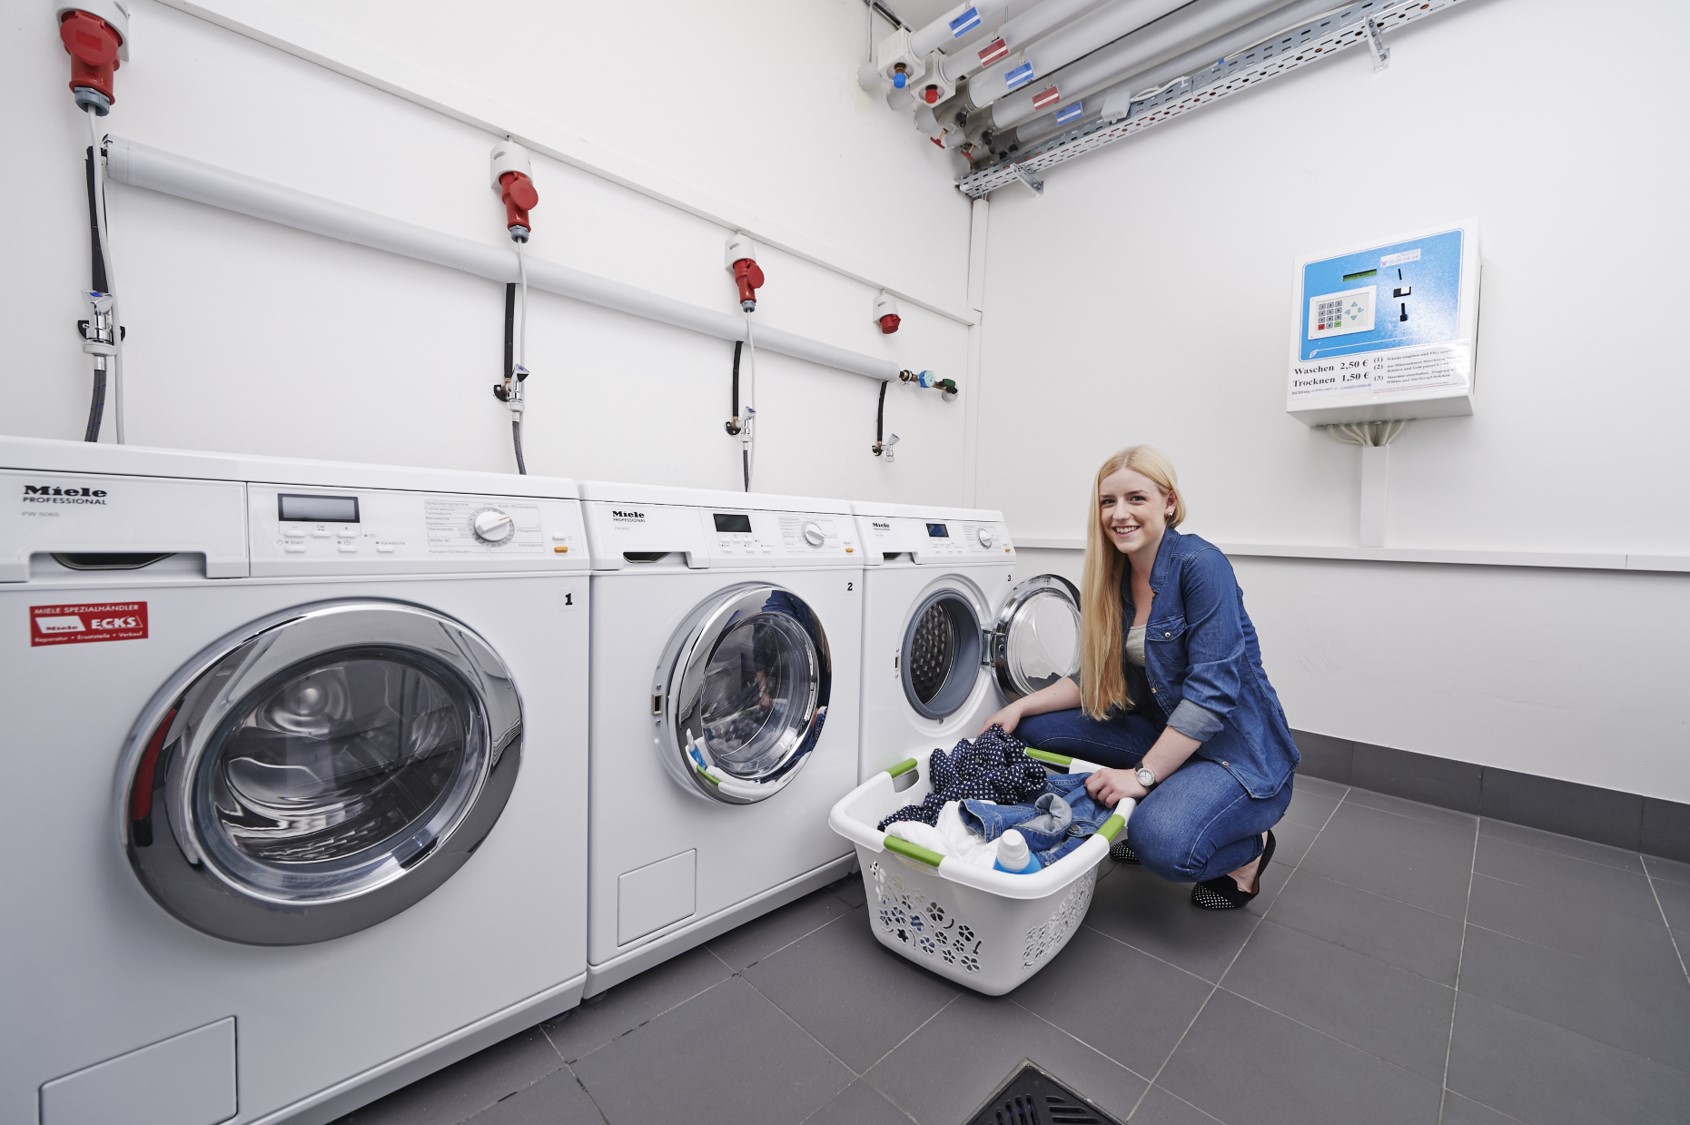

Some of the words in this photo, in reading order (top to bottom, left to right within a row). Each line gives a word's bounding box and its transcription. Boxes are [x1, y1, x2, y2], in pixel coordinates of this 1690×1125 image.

[1294, 365, 1334, 375] Waschen
[1362, 359, 1369, 367] €
[1293, 377, 1335, 387] Trocknen
[1363, 372, 1370, 380] €
[23, 485, 108, 498] Miele
[22, 497, 107, 505] PROFESSIONAL
[612, 510, 645, 518] Miele
[847, 582, 853, 591] 2
[565, 593, 573, 605] 1
[34, 607, 61, 615] MIELE
[64, 604, 139, 613] SPEZIALHÄNDLER
[91, 616, 136, 629] ECKS
